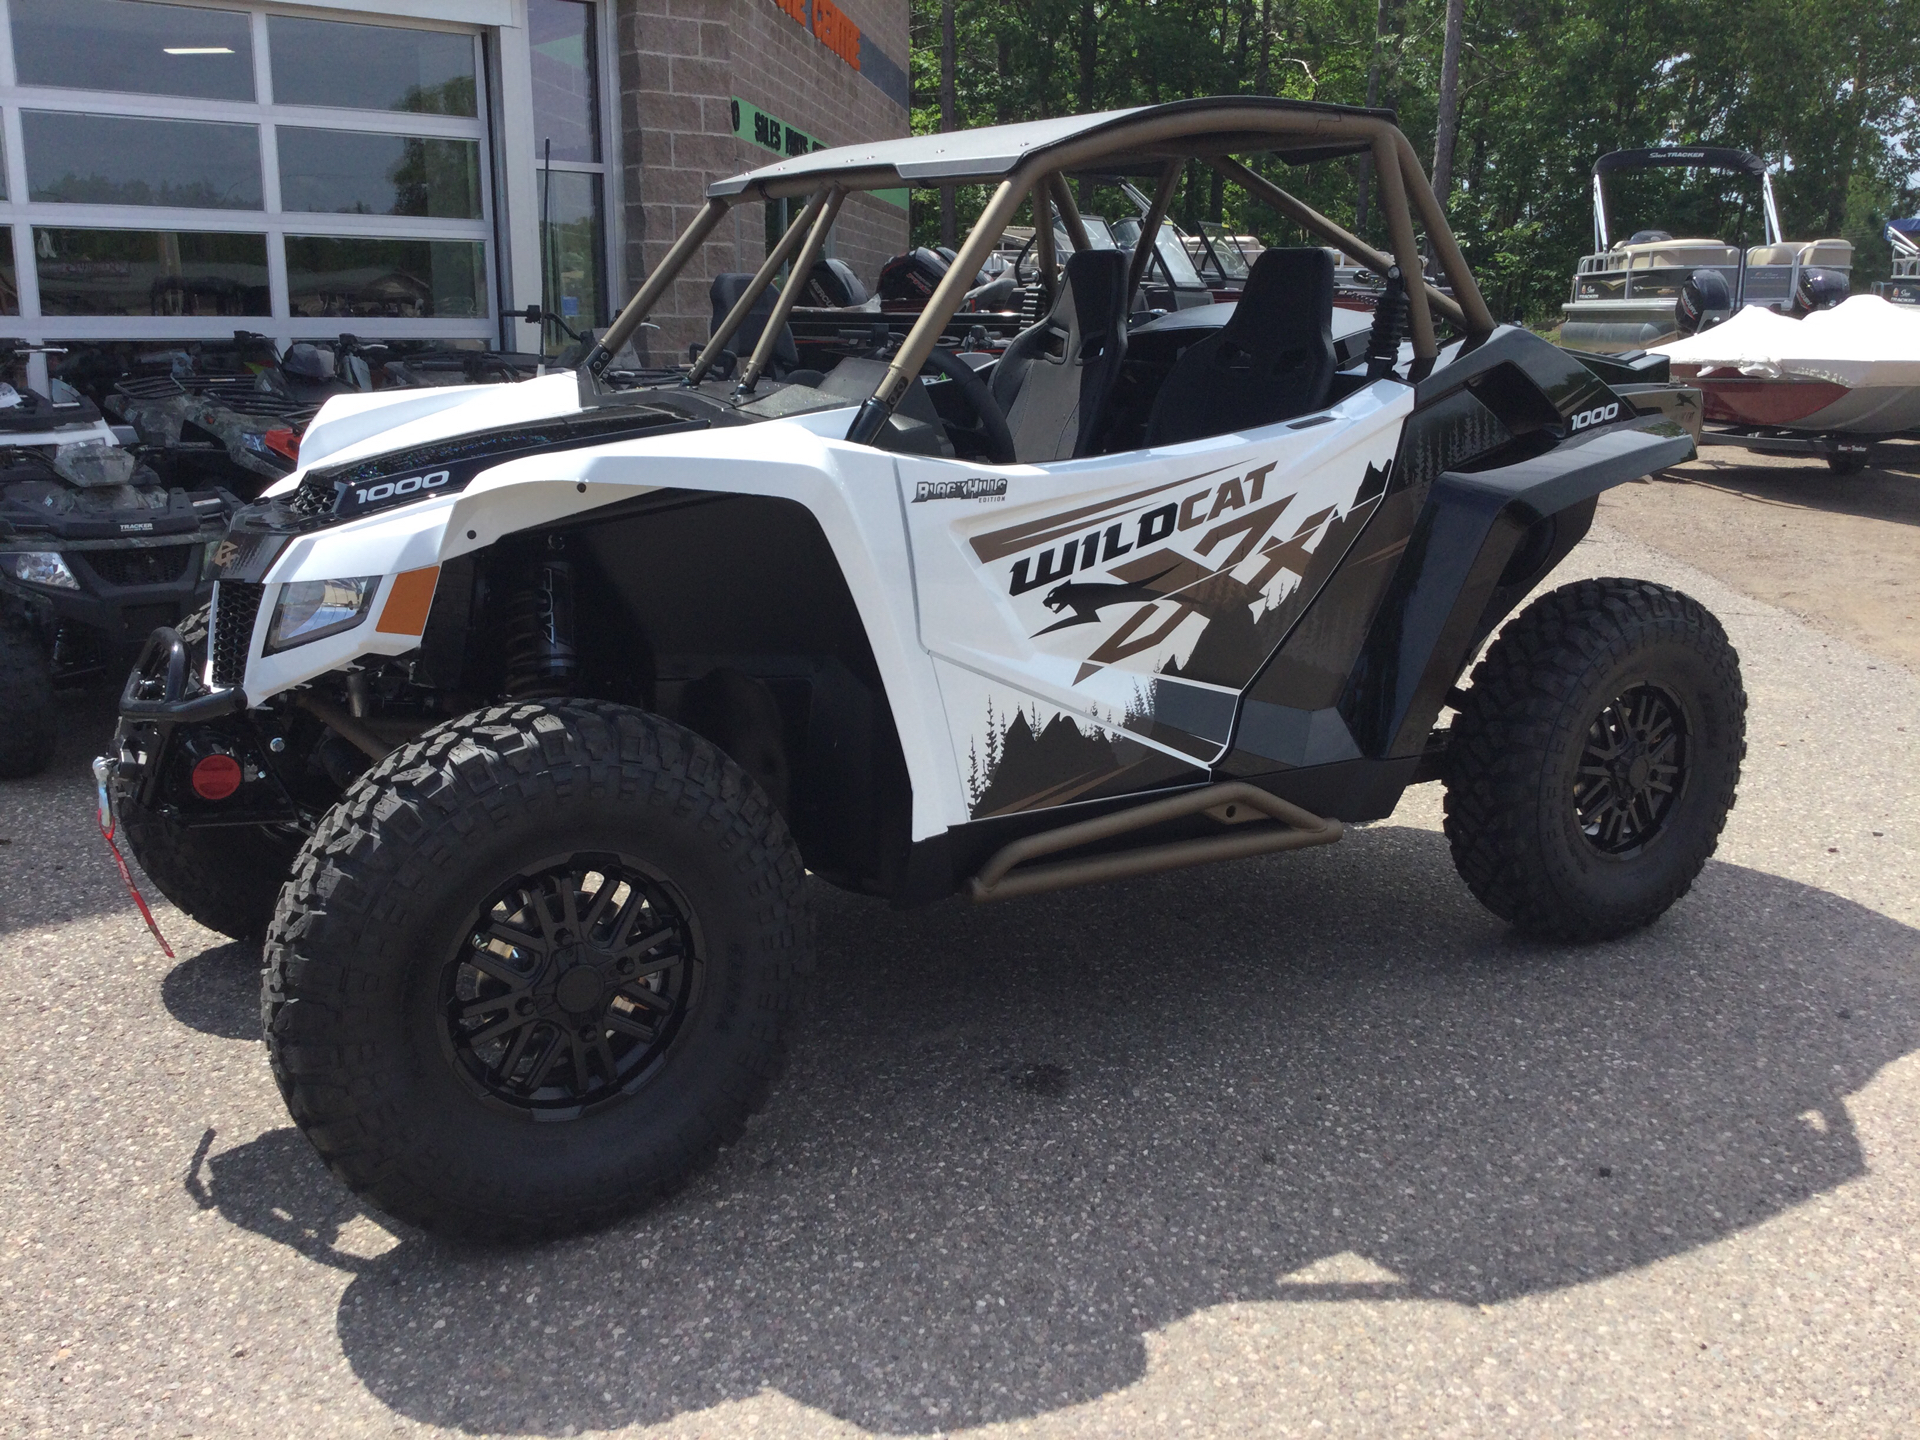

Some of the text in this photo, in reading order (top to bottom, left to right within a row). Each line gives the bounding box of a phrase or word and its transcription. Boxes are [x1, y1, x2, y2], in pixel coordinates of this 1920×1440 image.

[754, 111, 782, 152] SALES
[810, 278, 836, 308] MERCU
[1571, 402, 1619, 431] 1000
[356, 470, 450, 504] 1000
[978, 496, 1006, 504] EDITION
[1009, 460, 1278, 596] WILDCAT
